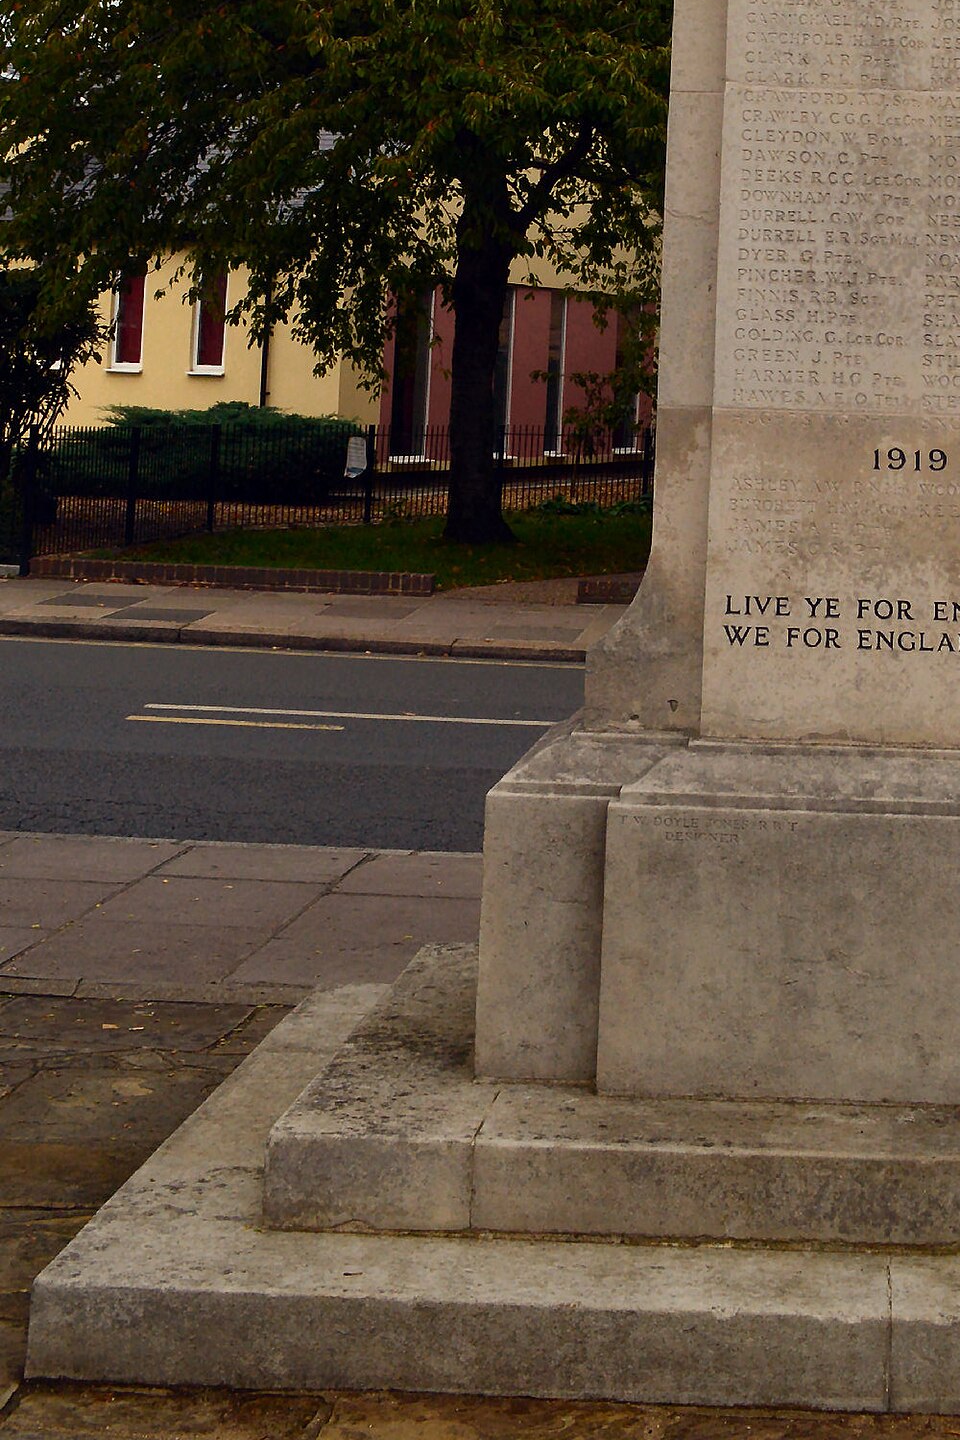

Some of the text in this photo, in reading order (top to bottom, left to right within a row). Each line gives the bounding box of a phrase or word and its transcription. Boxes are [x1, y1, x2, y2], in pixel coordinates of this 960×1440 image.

[873, 448, 948, 471] 1919
[724, 595, 790, 617] LIVE
[804, 597, 841, 618] YE
[857, 599, 914, 620] FOR
[723, 625, 770, 648] WE
[787, 628, 841, 650] FOR
[653, 817, 699, 828] DOYLE
[665, 832, 739, 843] DESIGNER
